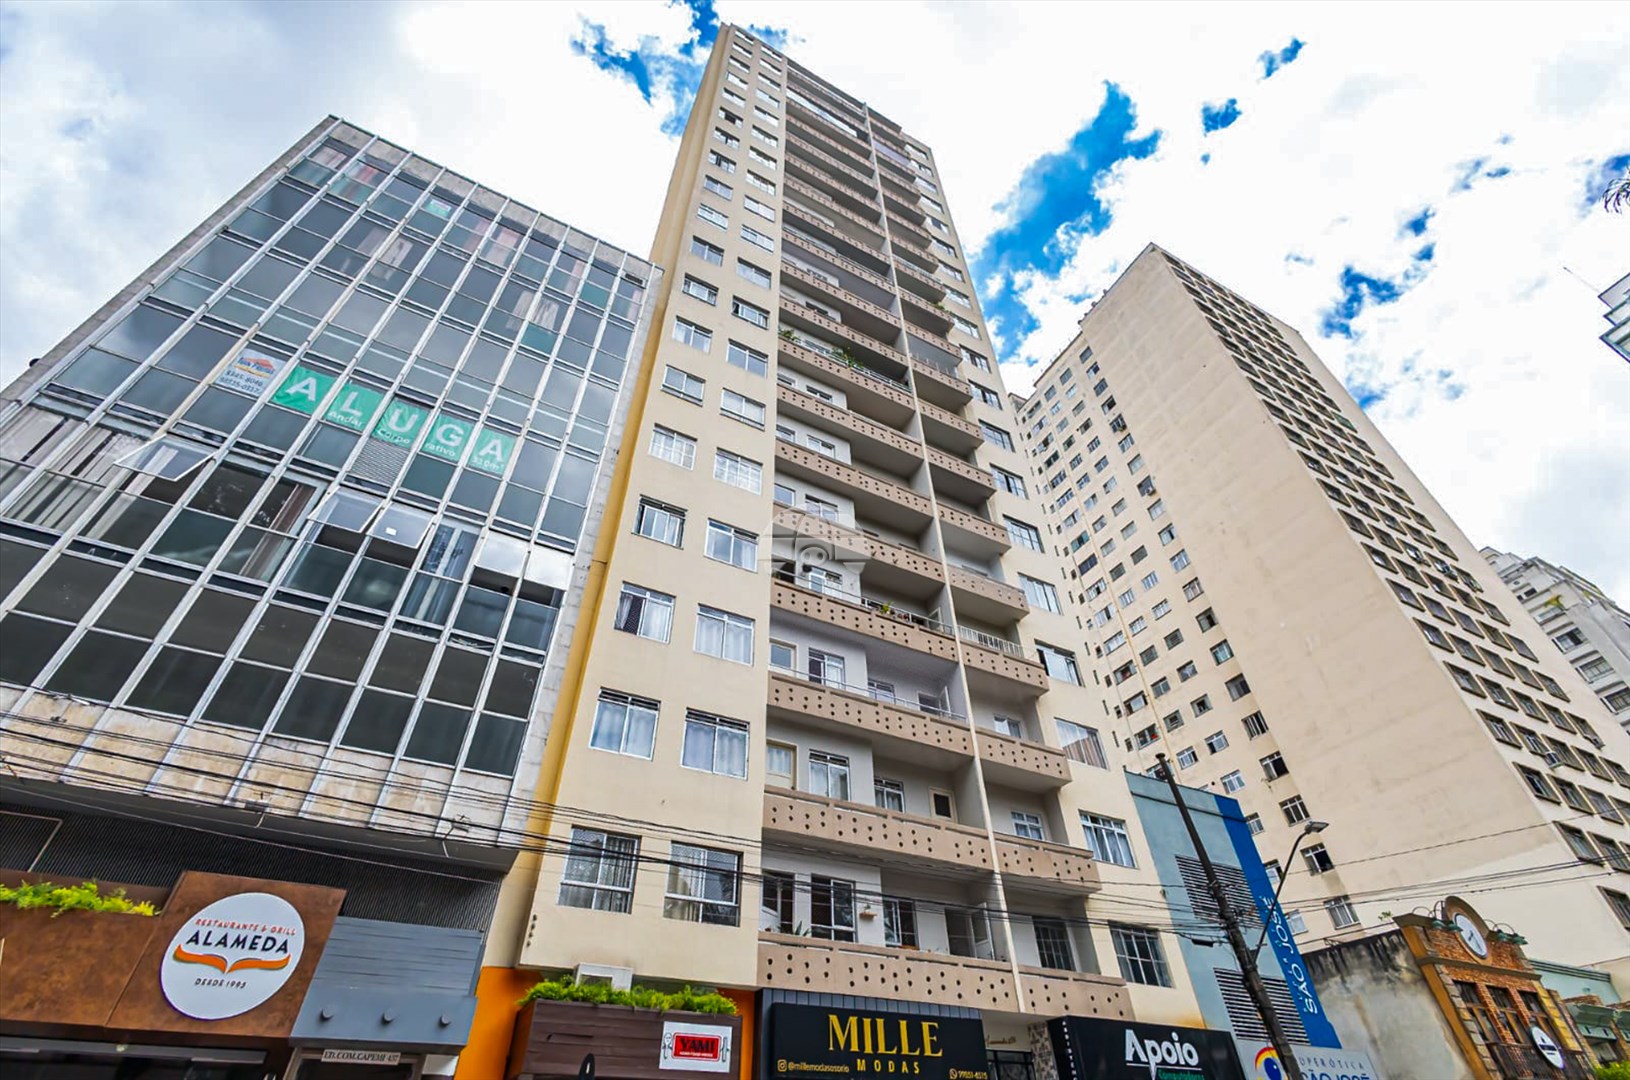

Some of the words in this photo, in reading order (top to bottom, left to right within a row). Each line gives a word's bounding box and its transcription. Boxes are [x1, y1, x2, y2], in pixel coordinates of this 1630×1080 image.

[186, 930, 288, 953] ALAMEDA
[194, 978, 224, 987] DESDE
[828, 1014, 943, 1057] MILLE
[856, 1058, 920, 1074] MODAS
[1125, 1029, 1199, 1080] Apoio
